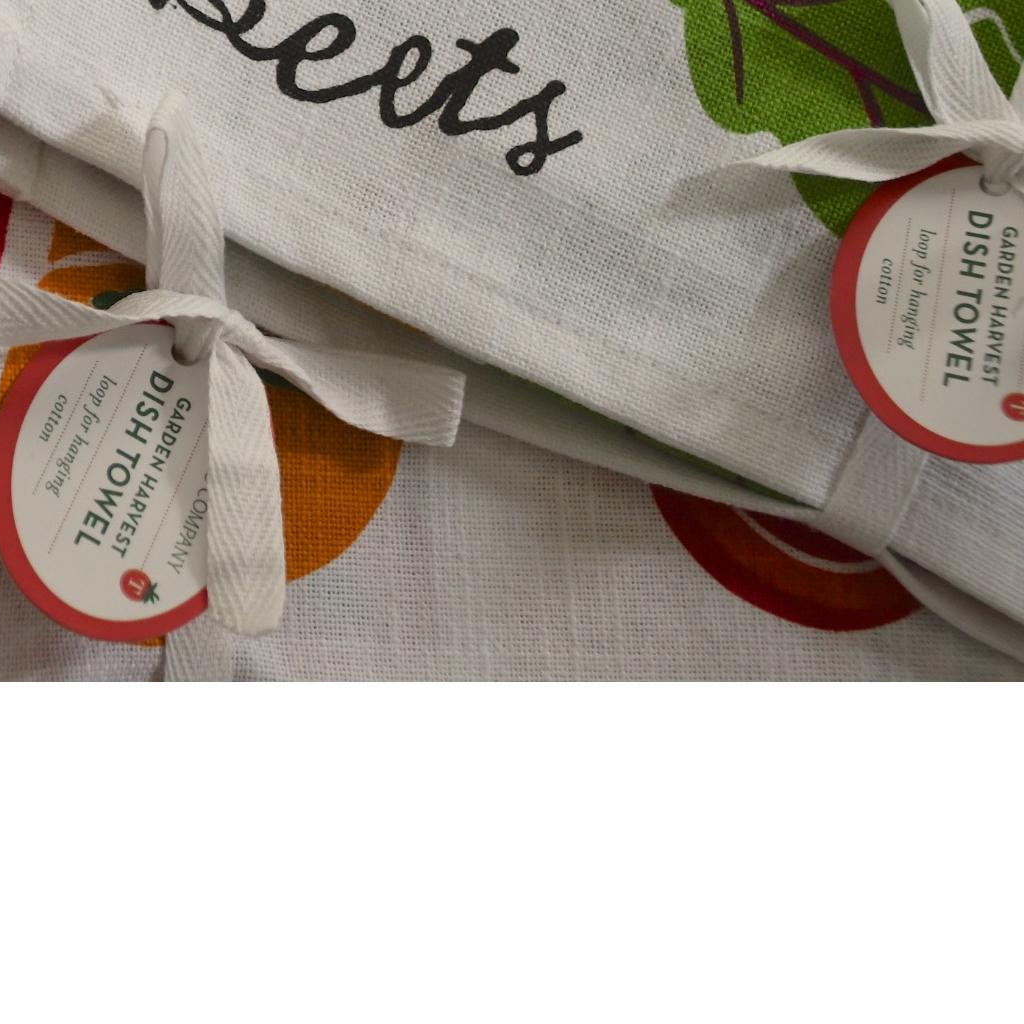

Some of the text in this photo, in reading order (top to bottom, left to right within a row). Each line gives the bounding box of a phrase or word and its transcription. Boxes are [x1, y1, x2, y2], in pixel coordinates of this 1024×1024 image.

[876, 257, 893, 305] cotton
[897, 228, 937, 350] loop for hanging
[942, 210, 994, 387] DISH TOWEL
[982, 227, 1019, 387] GARDEN HARVEST
[39, 393, 68, 443] cotton
[45, 375, 117, 498] loop for hanging
[73, 370, 175, 547] DISH TOWEL
[112, 397, 191, 558] GARDEN HARVEST
